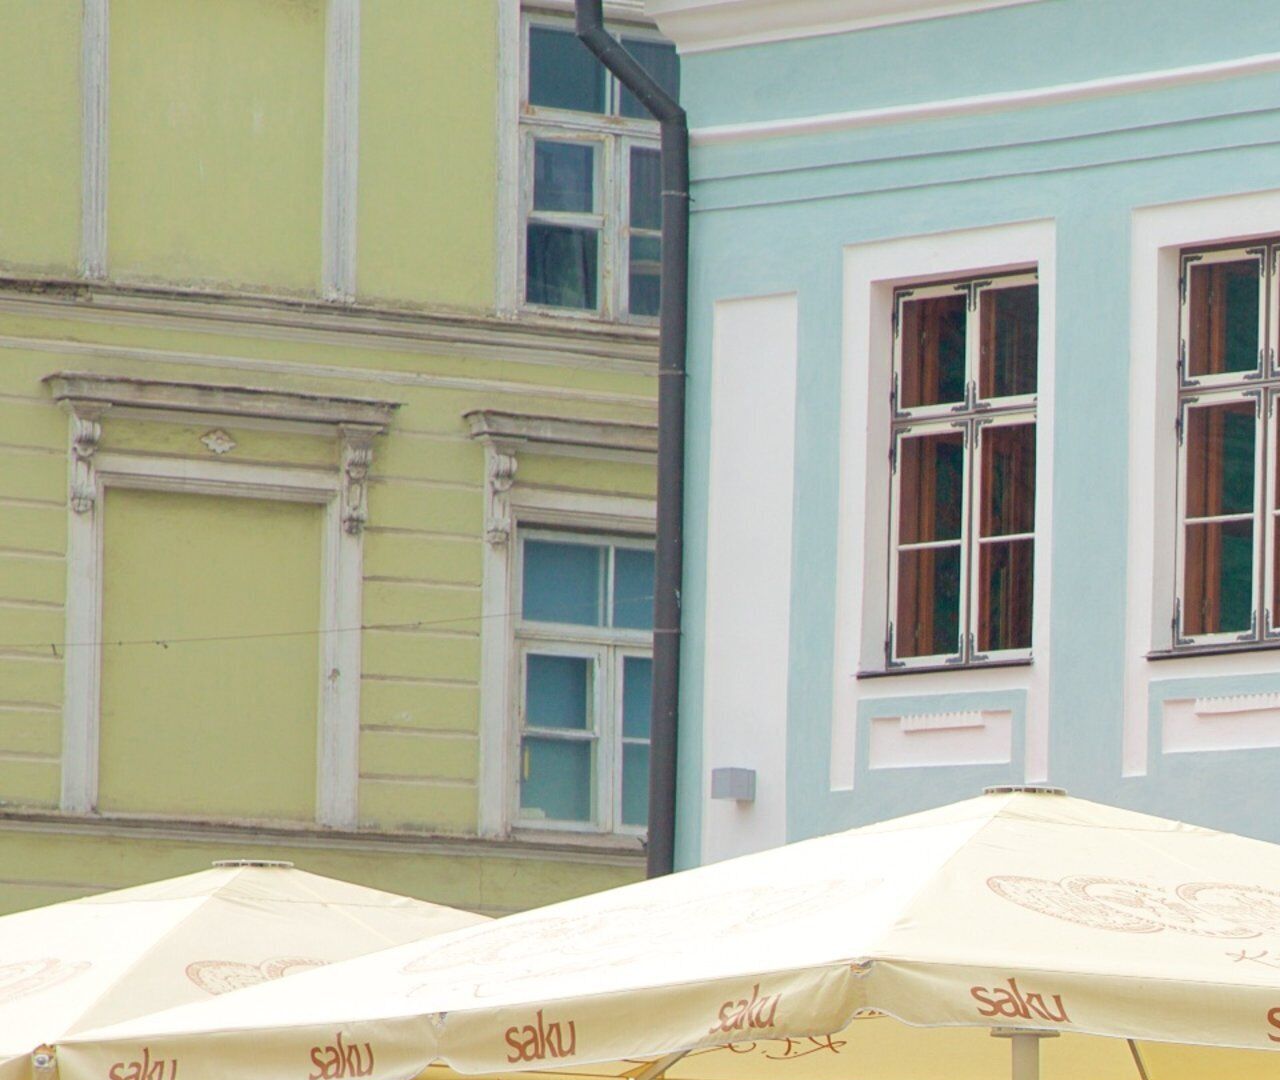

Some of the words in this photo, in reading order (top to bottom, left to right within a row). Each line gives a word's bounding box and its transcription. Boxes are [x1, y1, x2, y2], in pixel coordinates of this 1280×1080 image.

[709, 983, 782, 1034] saku
[970, 977, 1071, 1023] saku
[309, 1031, 374, 1080] saku
[505, 1009, 576, 1063] saku
